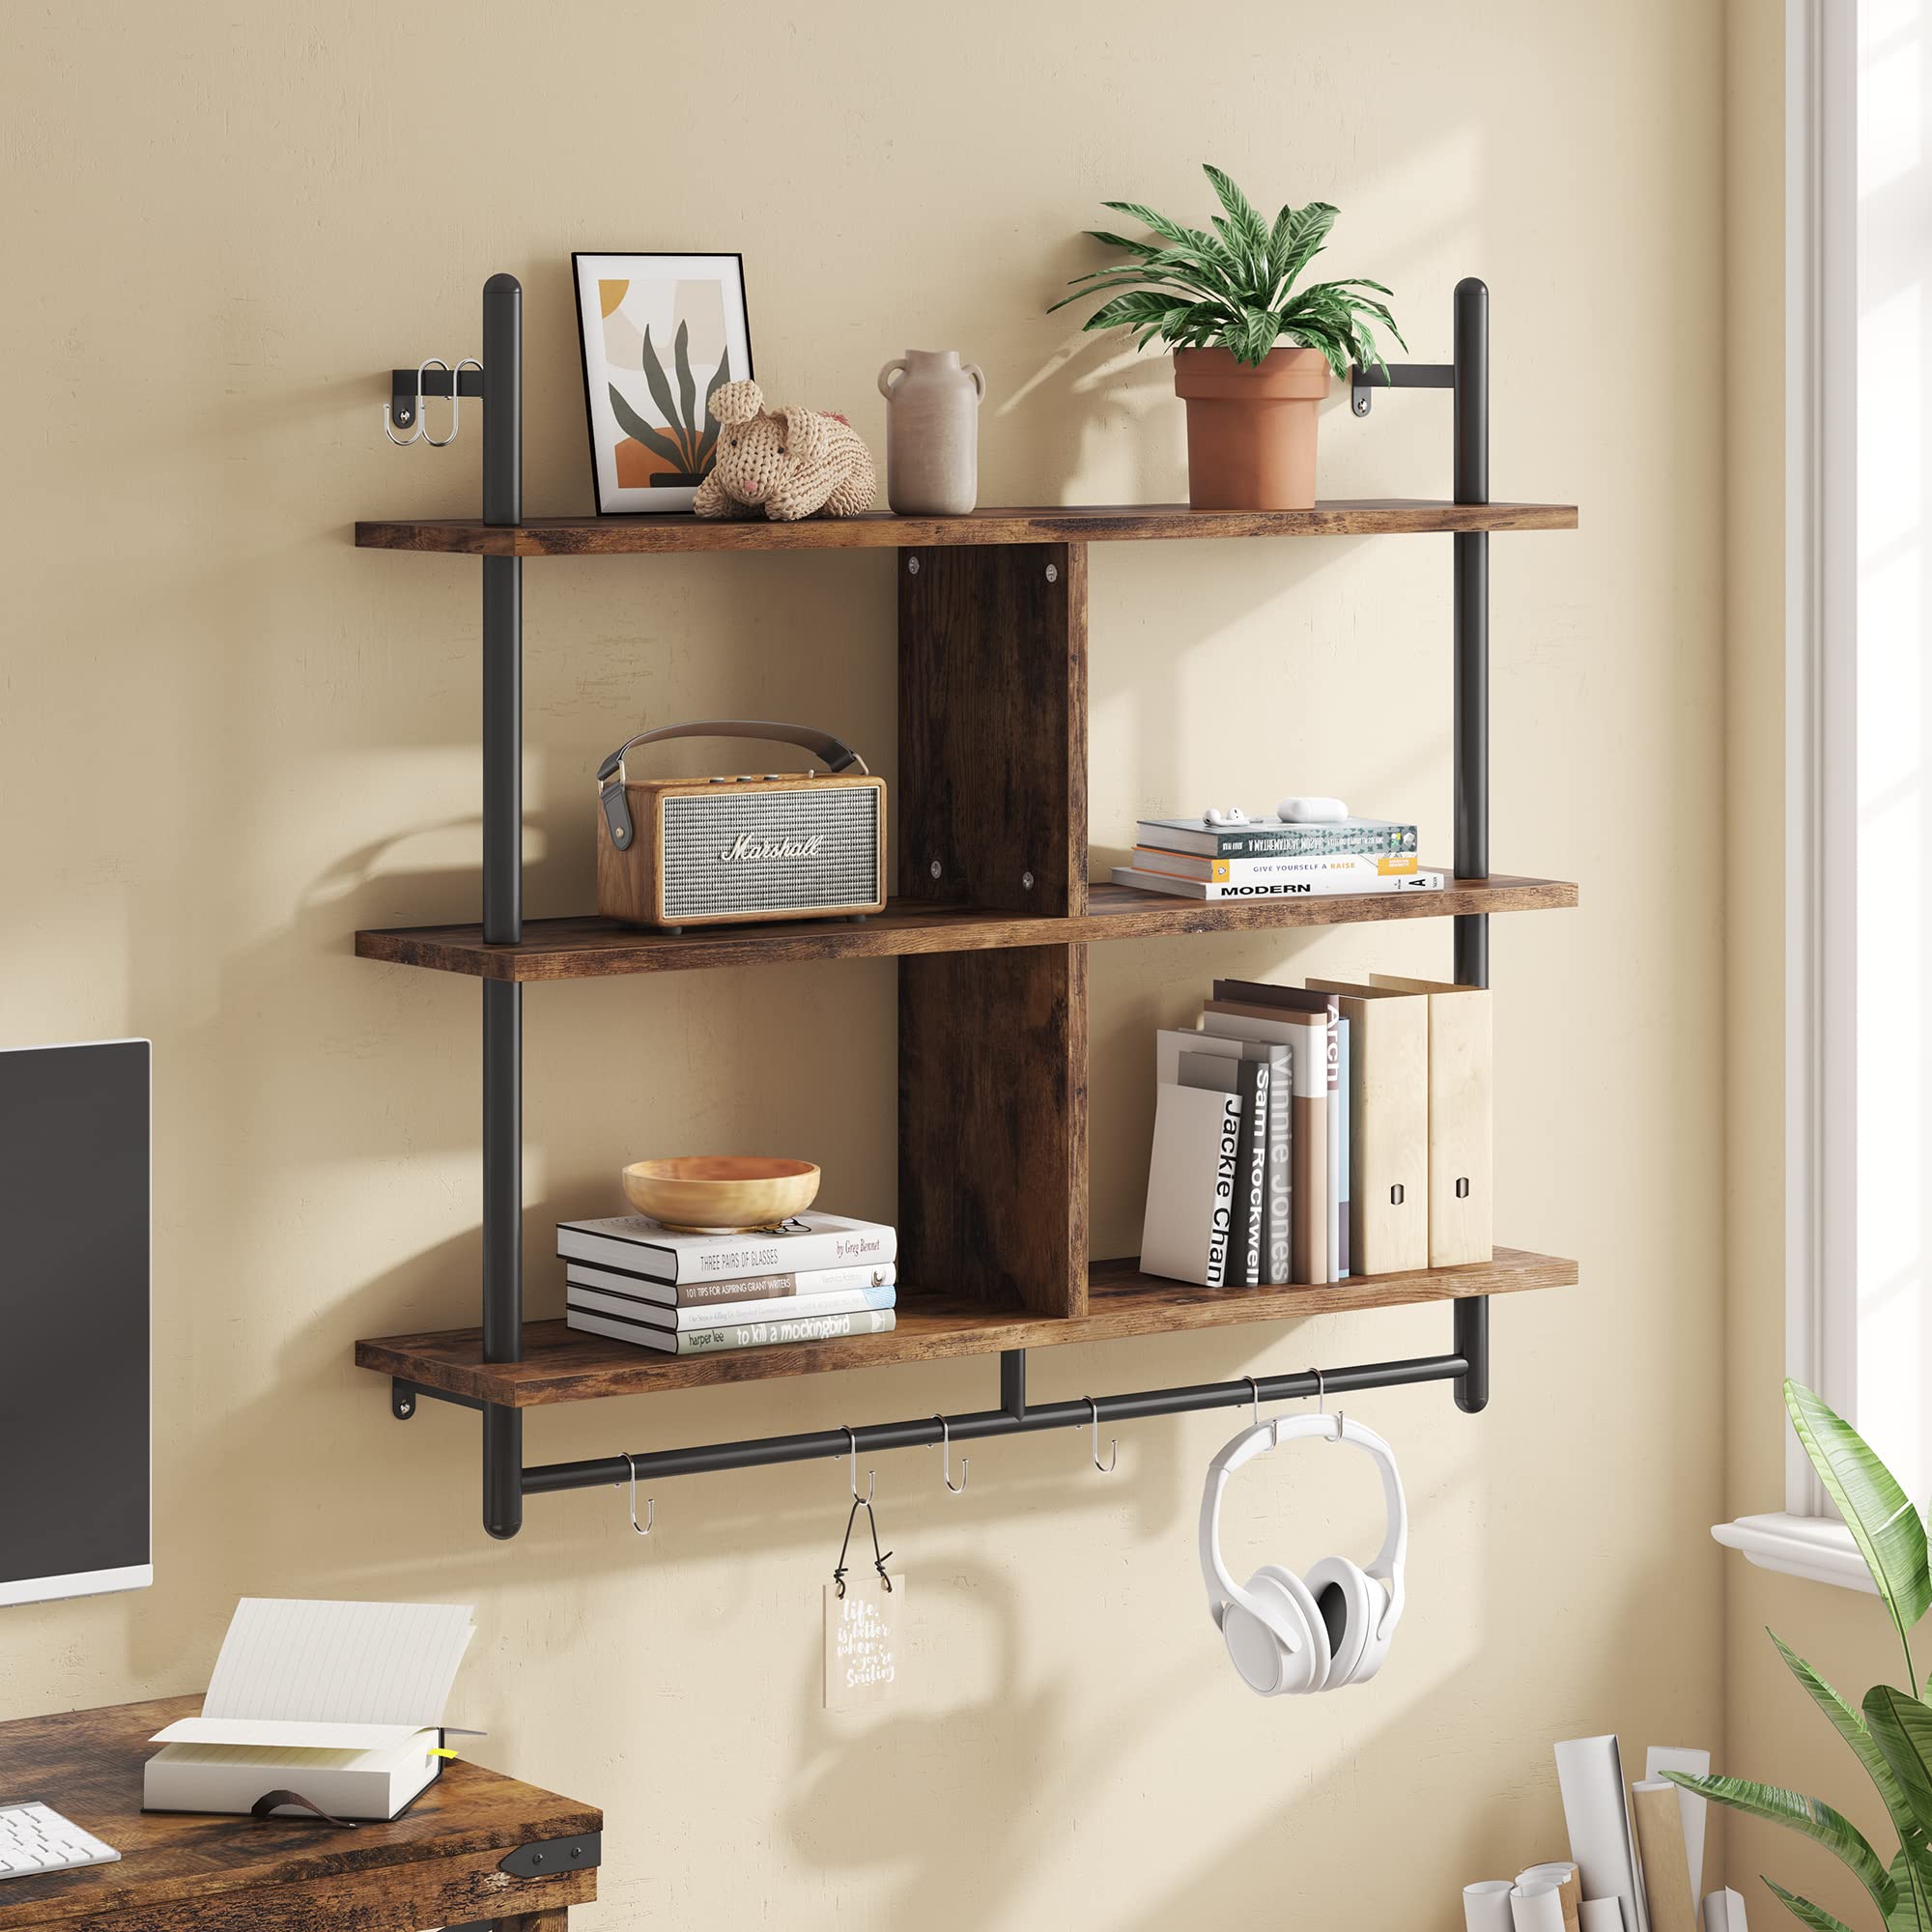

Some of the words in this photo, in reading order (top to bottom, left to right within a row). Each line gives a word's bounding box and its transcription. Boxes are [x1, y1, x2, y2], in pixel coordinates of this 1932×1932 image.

[722, 833, 821, 860] Marshall
[1276, 864, 1319, 872] YOURSELF
[1408, 878, 1426, 887] A
[1221, 884, 1311, 896] MODERN
[1327, 1004, 1339, 1081] Arch
[1254, 1069, 1269, 1137] Sam
[1270, 1052, 1293, 1163] Vinnie
[1216, 1099, 1240, 1198] Jackie
[1246, 1148, 1265, 1283] Rockwell
[1270, 1174, 1293, 1281] Jones
[700, 1255, 720, 1271] THREE
[721, 1253, 740, 1269] PAIRS
[741, 1251, 750, 1267] OF
[751, 1248, 779, 1265] GLASSES
[837, 1240, 844, 1259] by
[845, 1240, 859, 1257] Greg
[1208, 1208, 1230, 1283] Chan
[686, 1289, 696, 1298] 101
[697, 1287, 708, 1296] TIPS
[709, 1285, 721, 1296] FOR
[722, 1282, 747, 1294] ASPIRING
[747, 1280, 767, 1292] GRANT
[768, 1278, 791, 1291] WRITERS
[689, 1333, 712, 1348] harper
[712, 1330, 724, 1343] lee
[737, 1328, 750, 1345] to
[751, 1323, 767, 1343] kill
[770, 1326, 778, 1342] a
[781, 1314, 850, 1339] mockingbird
